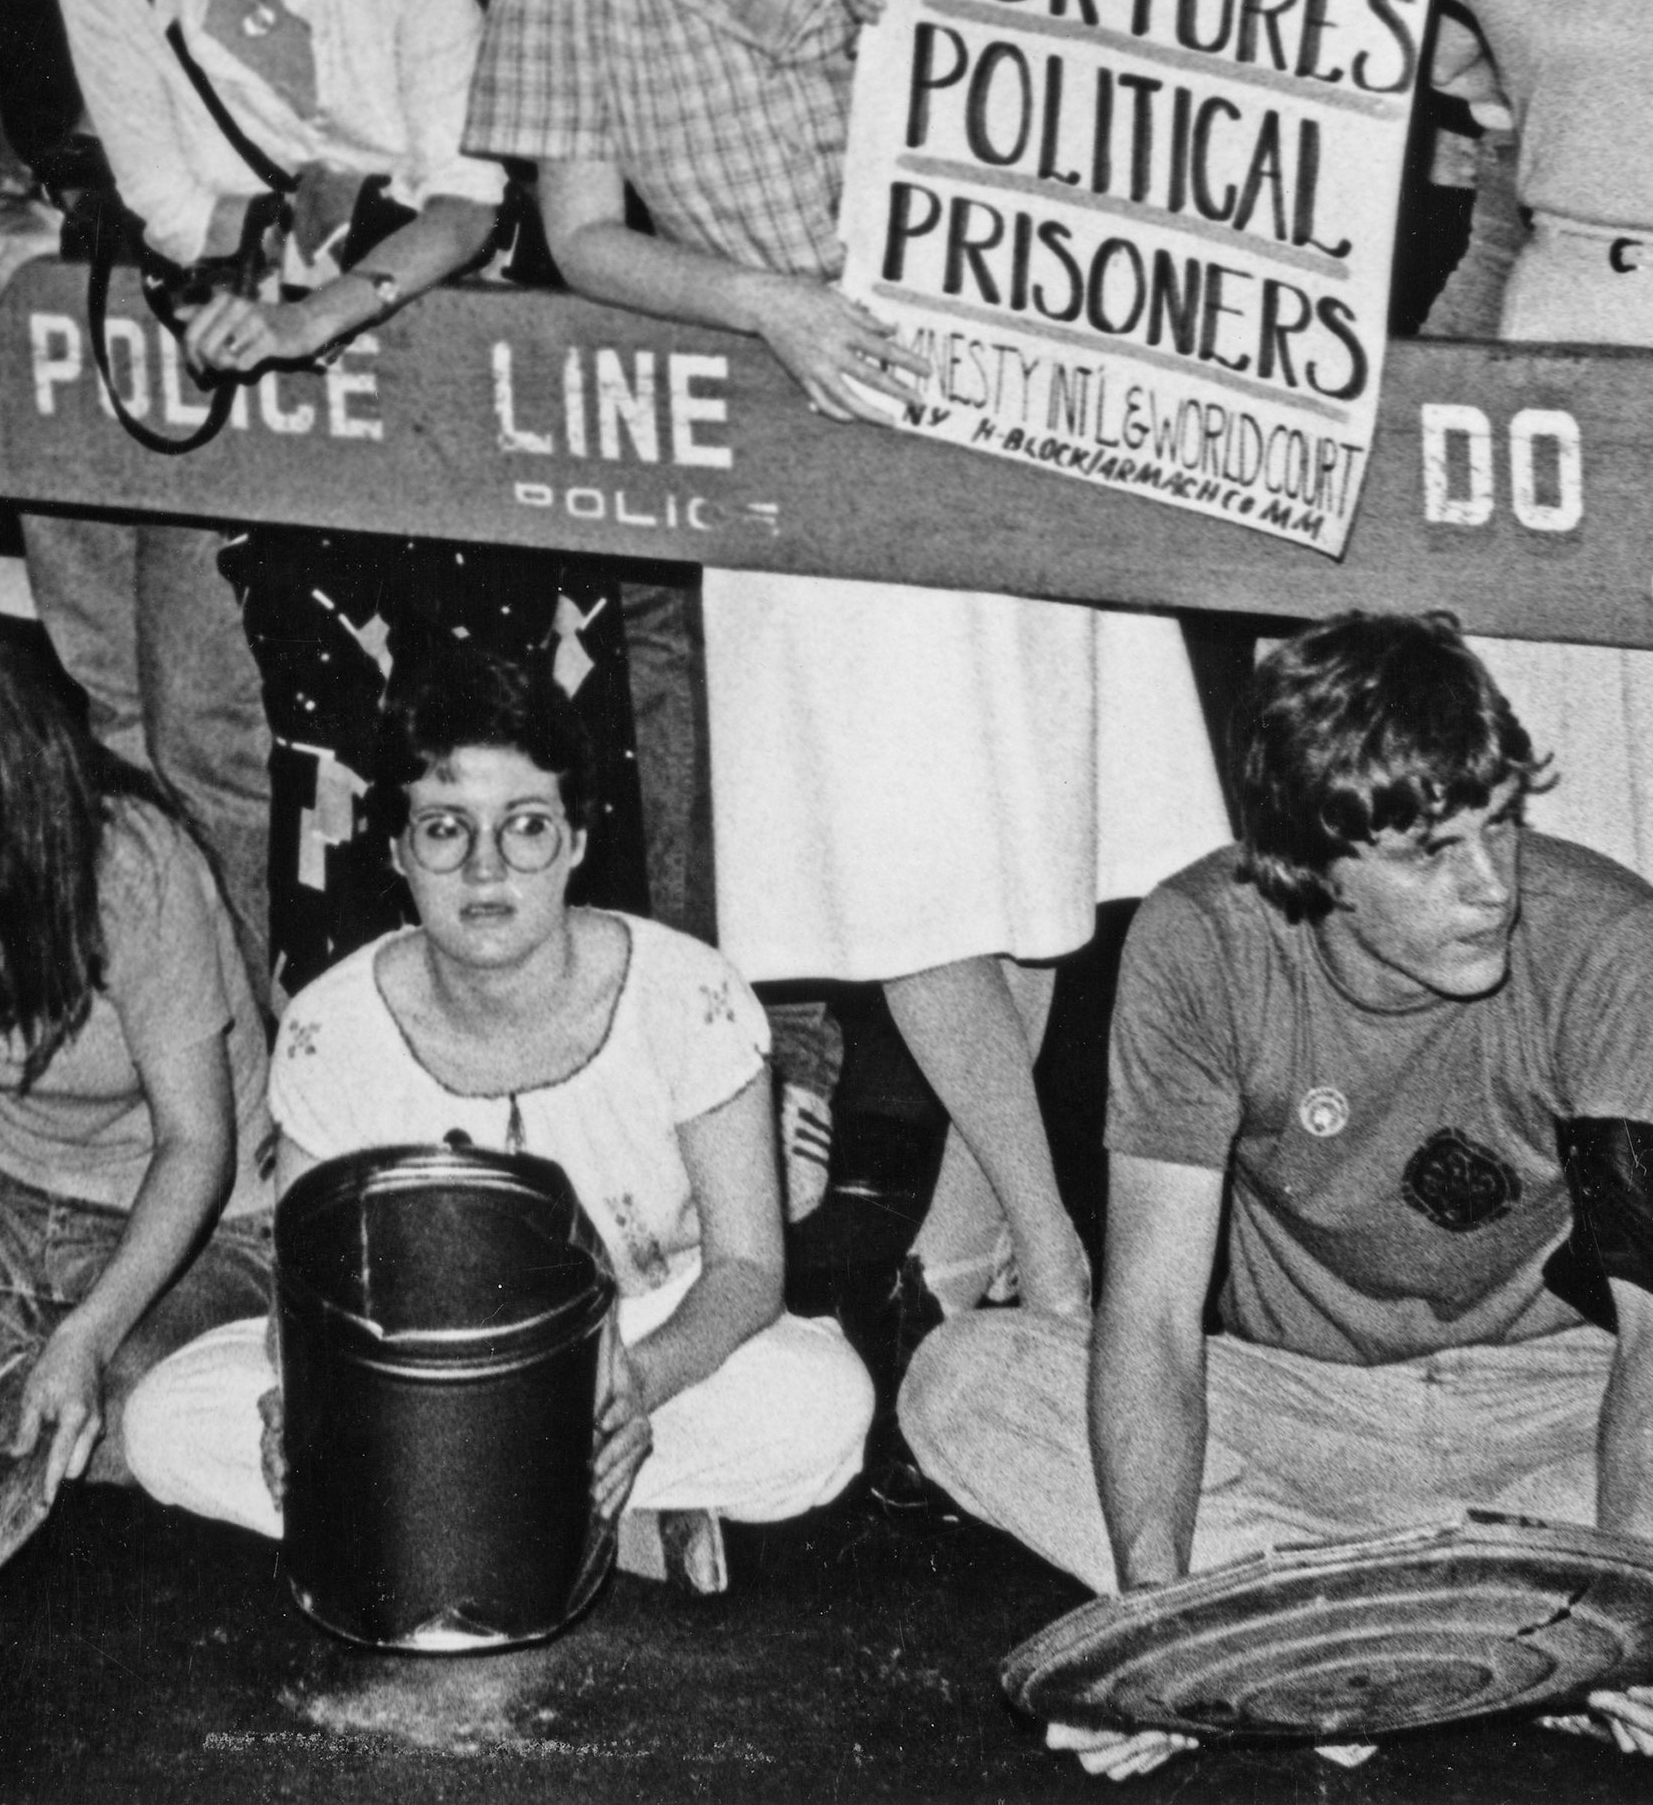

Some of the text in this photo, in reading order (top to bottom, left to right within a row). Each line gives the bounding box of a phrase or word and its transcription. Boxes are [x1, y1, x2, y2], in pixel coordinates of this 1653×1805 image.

[905, 21, 1353, 259] POLITICAL
[881, 181, 1369, 402] PRISONERS
[491, 340, 734, 468] LINE
[1420, 402, 1585, 531] DO
[1122, 385, 1151, 450] &
[1149, 390, 1265, 487] WORLD
[1264, 423, 1365, 519] COURT
